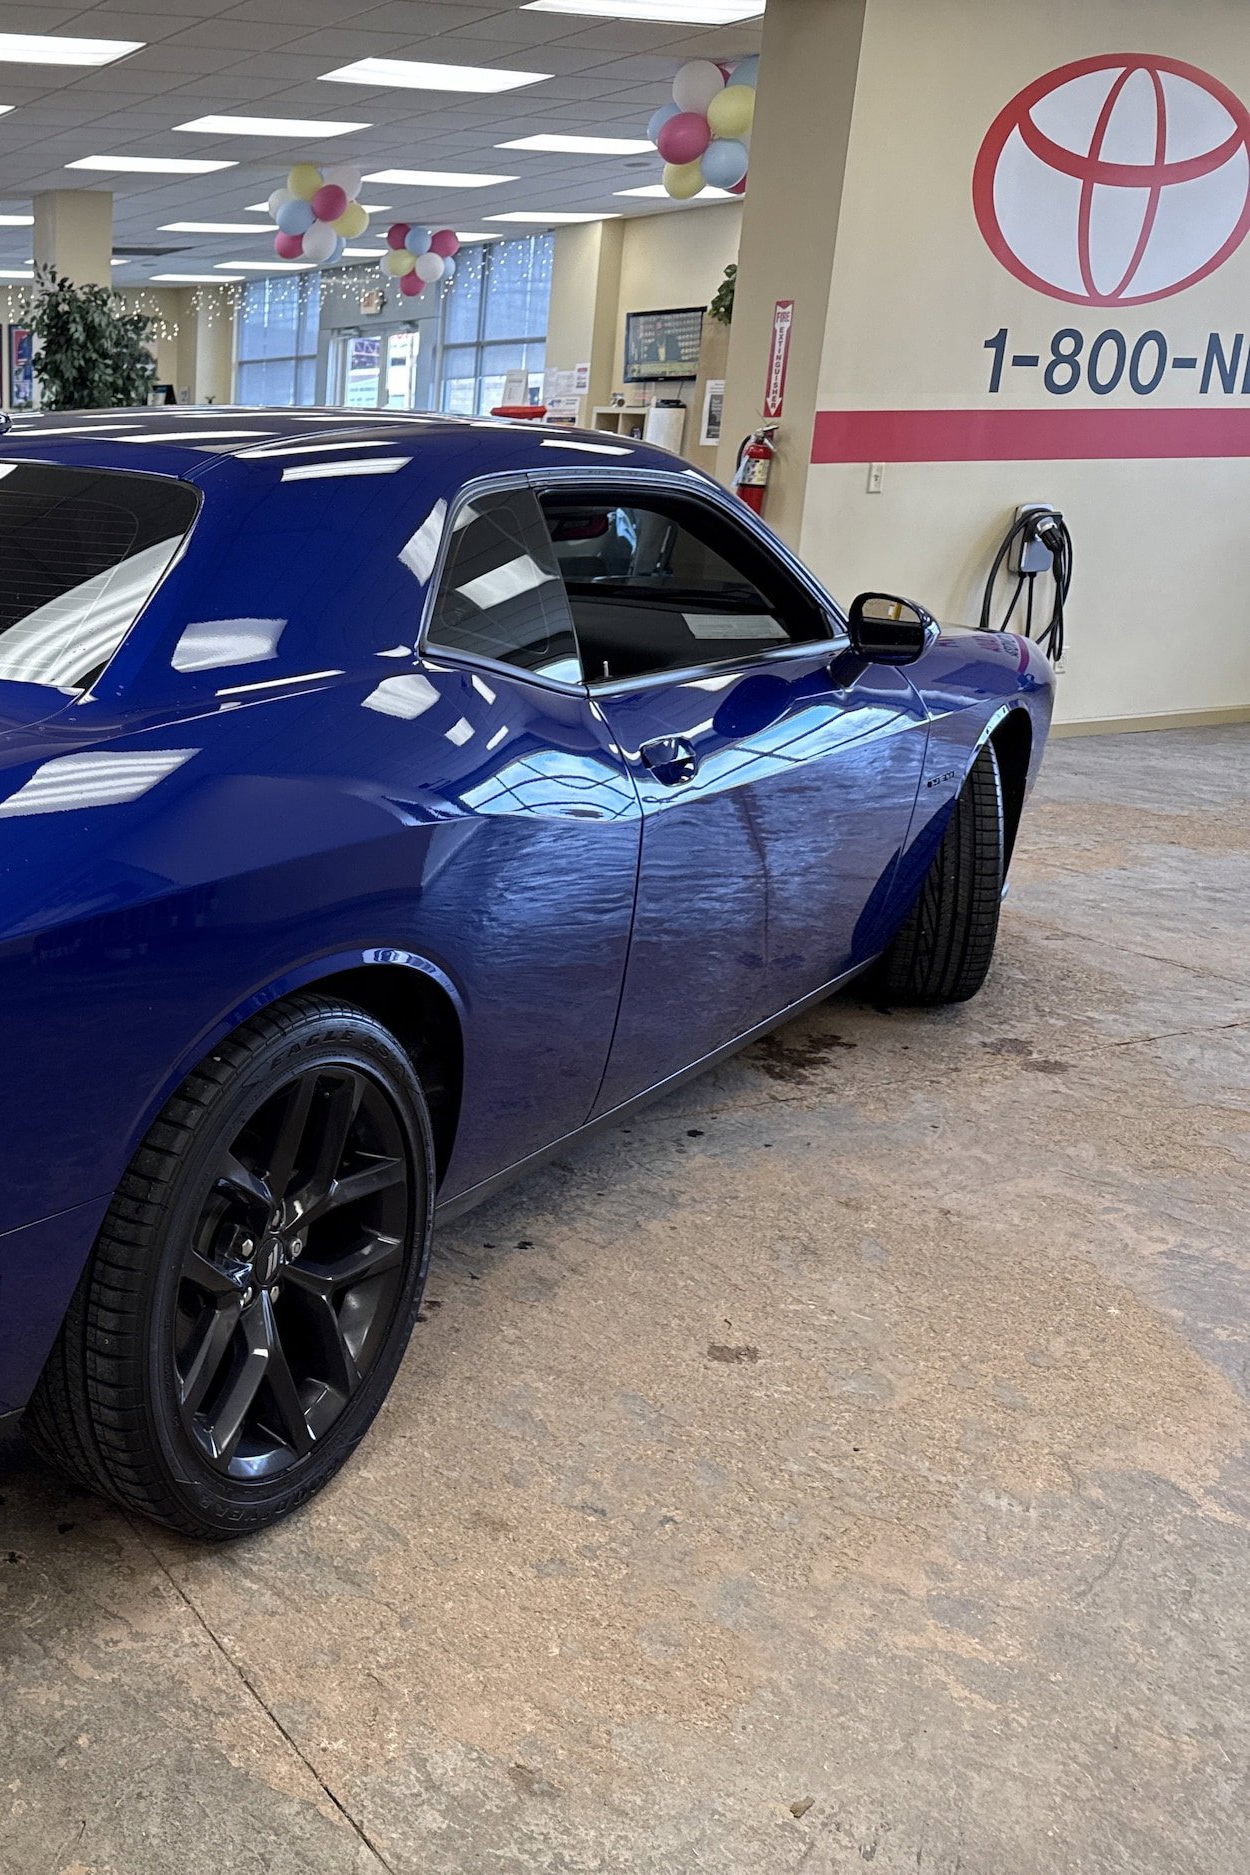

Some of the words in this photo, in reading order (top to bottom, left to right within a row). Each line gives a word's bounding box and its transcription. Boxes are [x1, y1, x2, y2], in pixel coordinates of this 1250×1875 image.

[776, 311, 791, 322] FIRE
[771, 326, 785, 409] EXTINGUISHER
[983, 328, 1250, 396] 1-800-N
[270, 1030, 356, 1072] EAGLE
